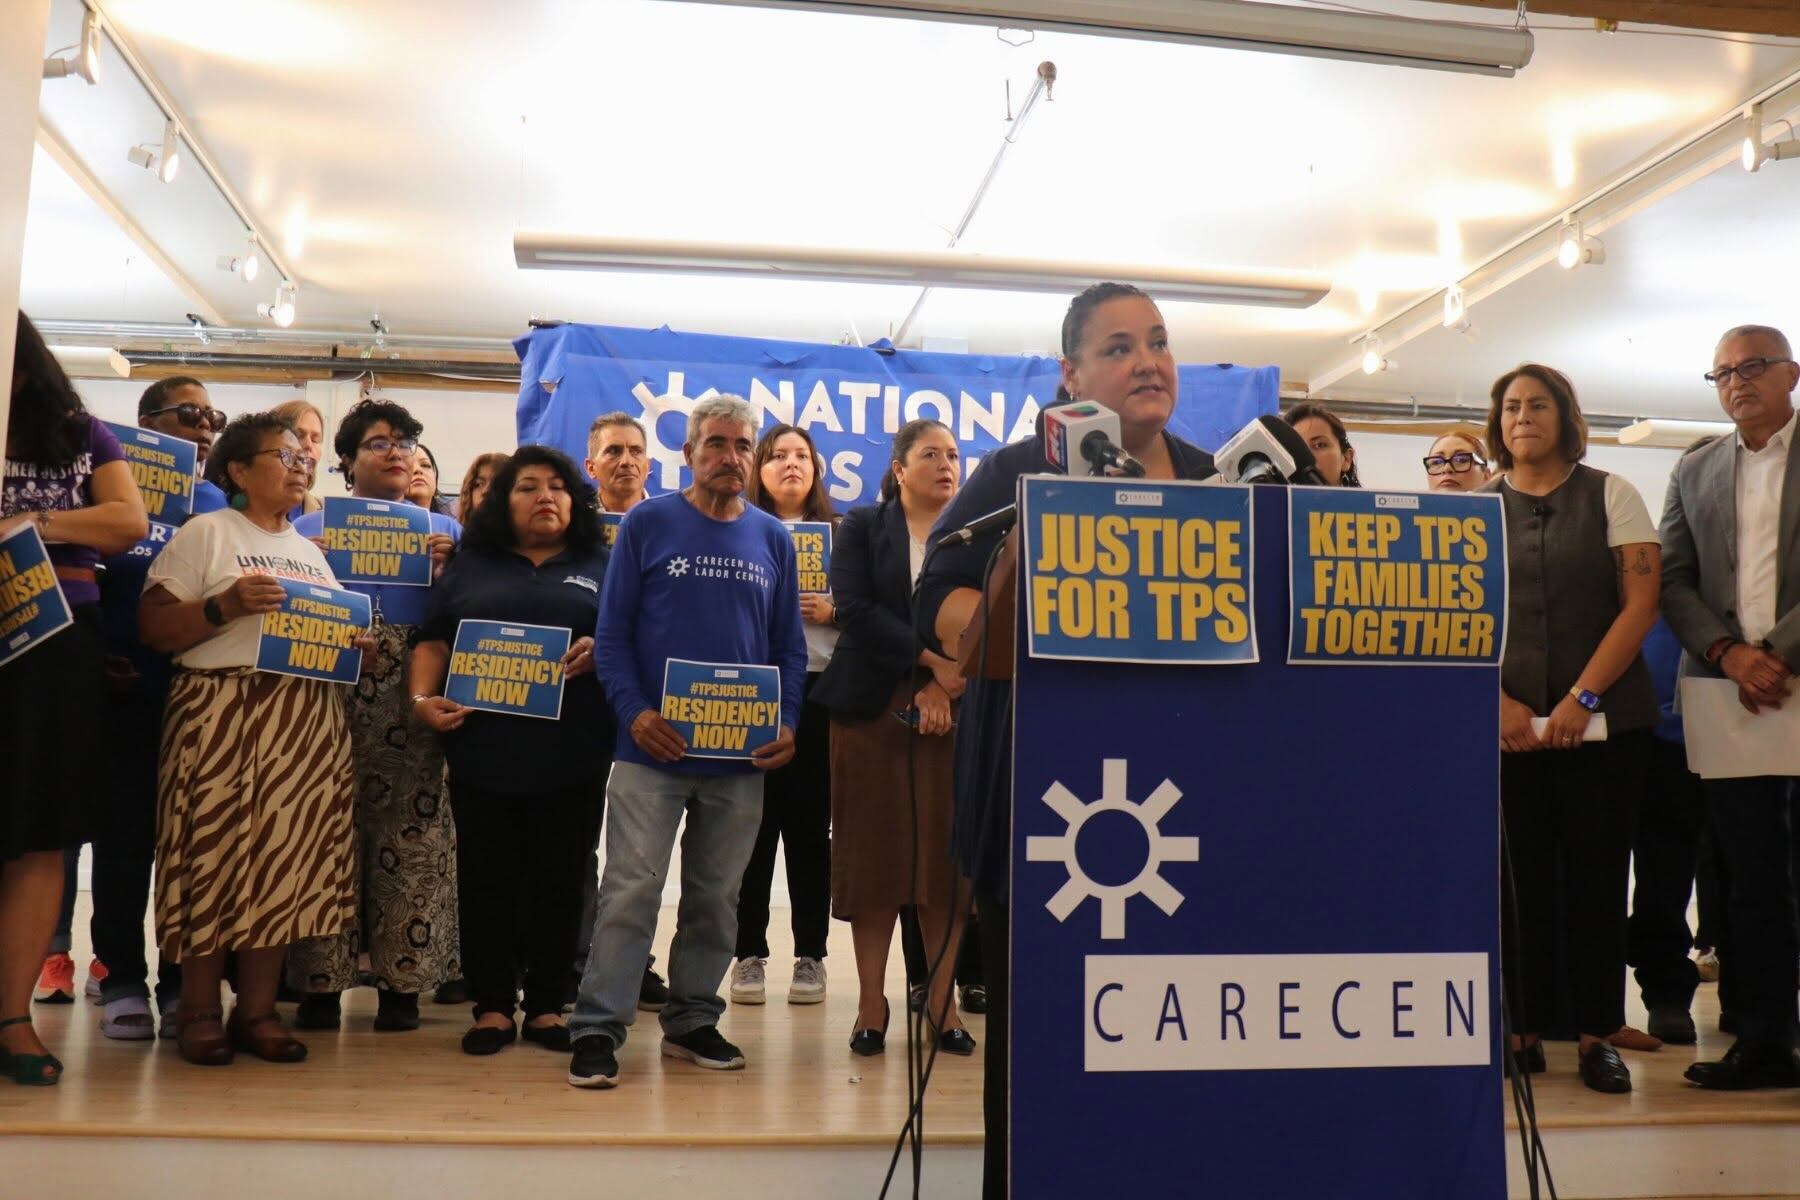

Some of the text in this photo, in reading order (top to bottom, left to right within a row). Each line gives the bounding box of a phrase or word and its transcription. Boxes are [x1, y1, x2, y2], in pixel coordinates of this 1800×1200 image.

[750, 377, 1042, 444] NATIONA
[122, 443, 176, 467] TPSJUSTICE
[346, 514, 409, 529] #TPSJUSTICE
[127, 546, 153, 557] OS
[323, 527, 431, 556] RESIDENCY
[791, 532, 824, 552] TPS
[1037, 513, 1242, 579] JUSTICE
[1308, 512, 1487, 563] KEEP TPS
[351, 551, 401, 577] NOW
[695, 567, 769, 588] LABOR CENTER
[696, 555, 765, 575] CARECEN DAY
[1314, 559, 1484, 610] FAMILIES
[290, 597, 352, 621] #TPSJUSTICE
[1032, 576, 1248, 643] FOR TPS
[1301, 609, 1495, 657] TOGETHER
[288, 641, 340, 673] NOW
[477, 639, 544, 657] #TPSJUSTICE
[450, 651, 565, 686] RESIDENCY
[475, 678, 530, 707] NOW
[690, 682, 758, 698] #TPSJUSTICE
[663, 695, 778, 727] RESIDENCY
[692, 724, 748, 751] NOW
[1093, 980, 1475, 1043] CARECEN
